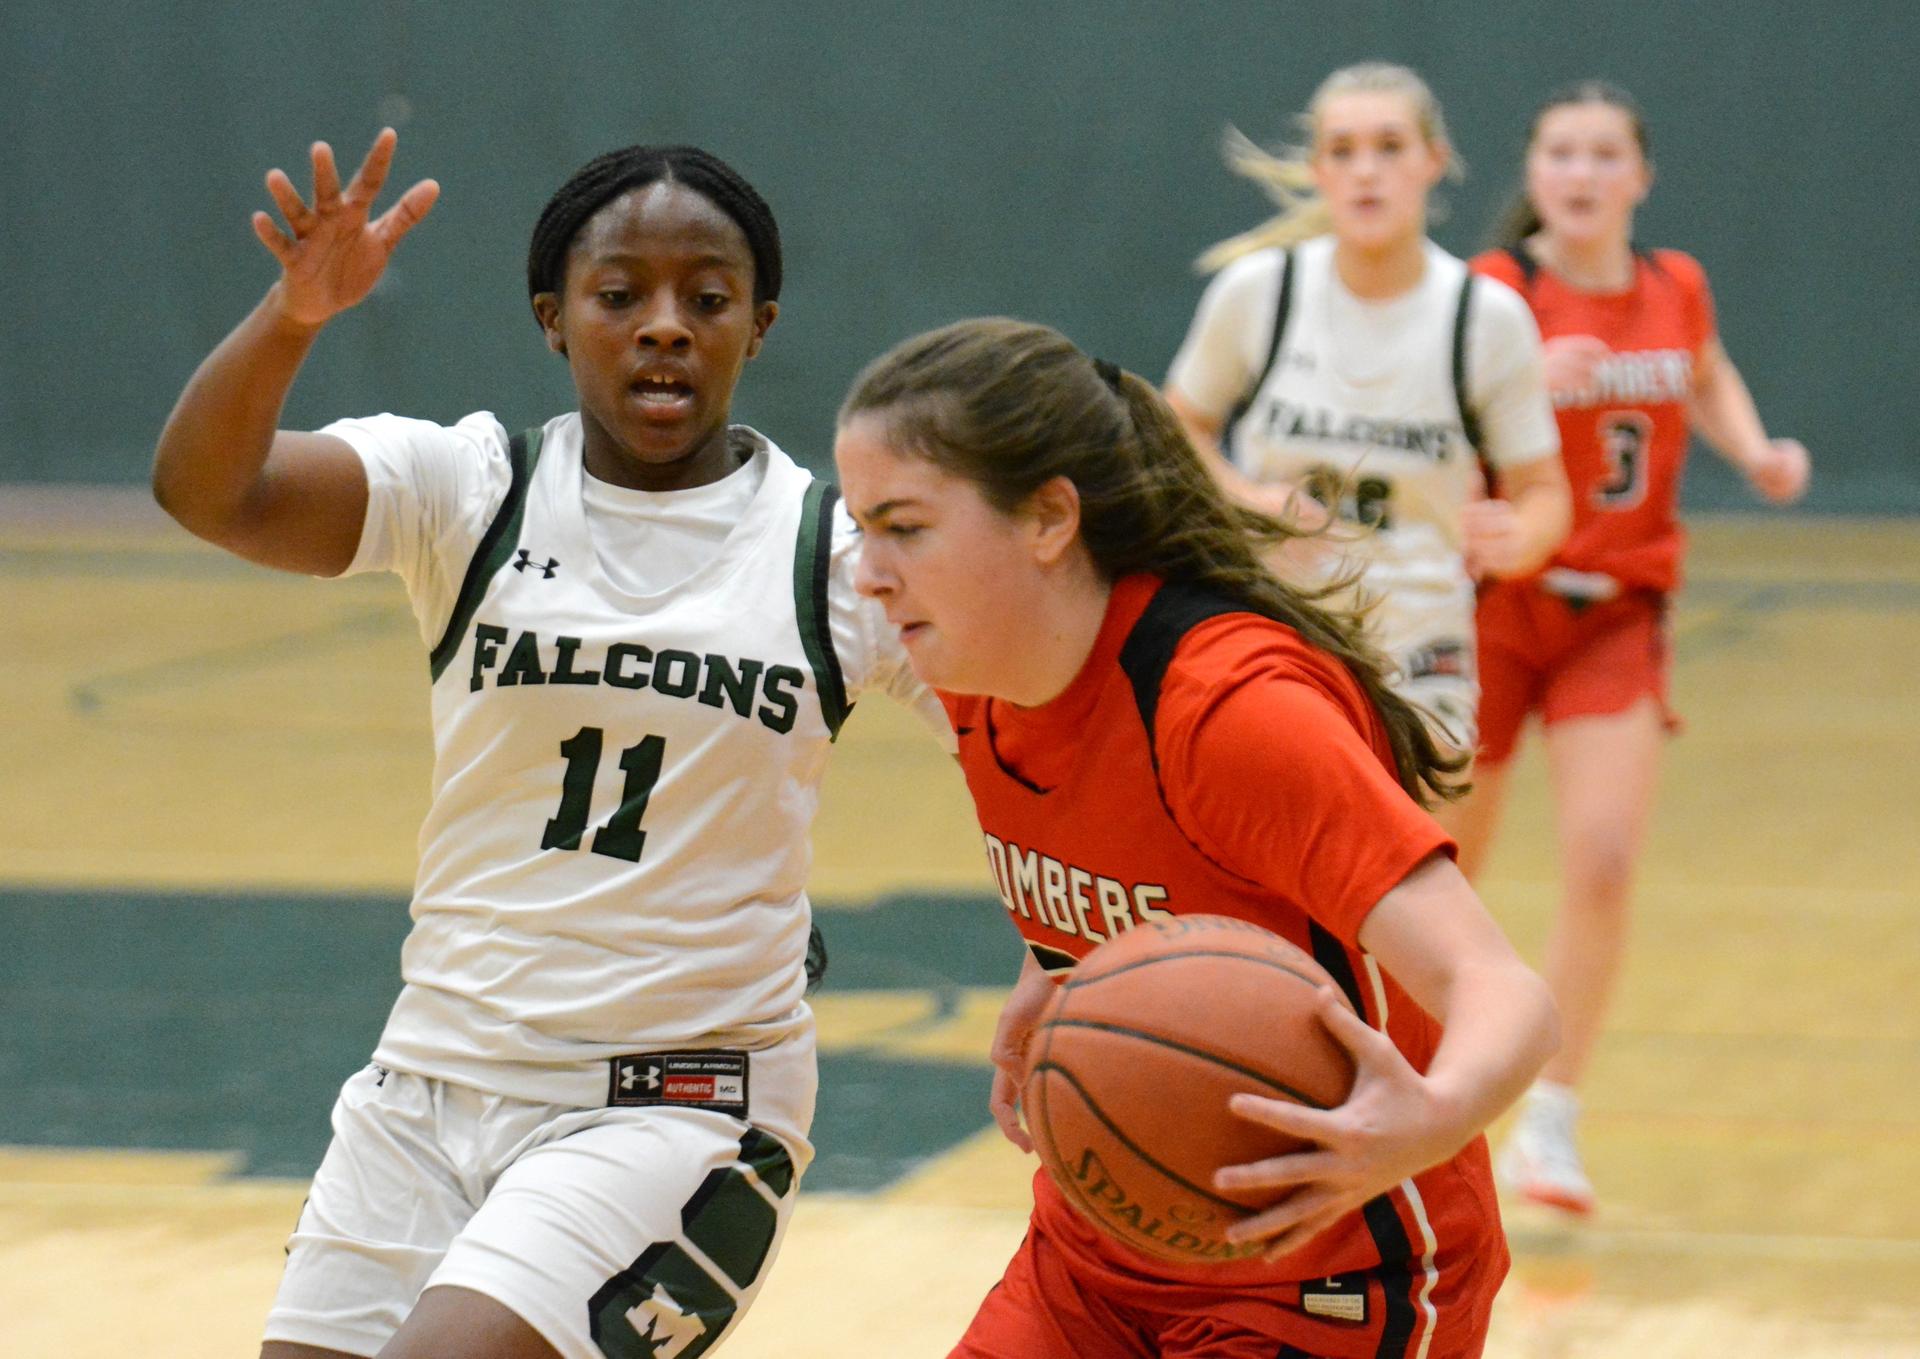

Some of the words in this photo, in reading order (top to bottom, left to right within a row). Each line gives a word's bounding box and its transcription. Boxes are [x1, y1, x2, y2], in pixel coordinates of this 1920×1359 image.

[1596, 414, 1650, 507] 3
[470, 622, 804, 735] FALCONS
[540, 726, 667, 863] 11
[666, 1082, 713, 1094] AUTHENTIC
[668, 1062, 701, 1070] UNDER
[702, 1062, 741, 1070] ARMOUR
